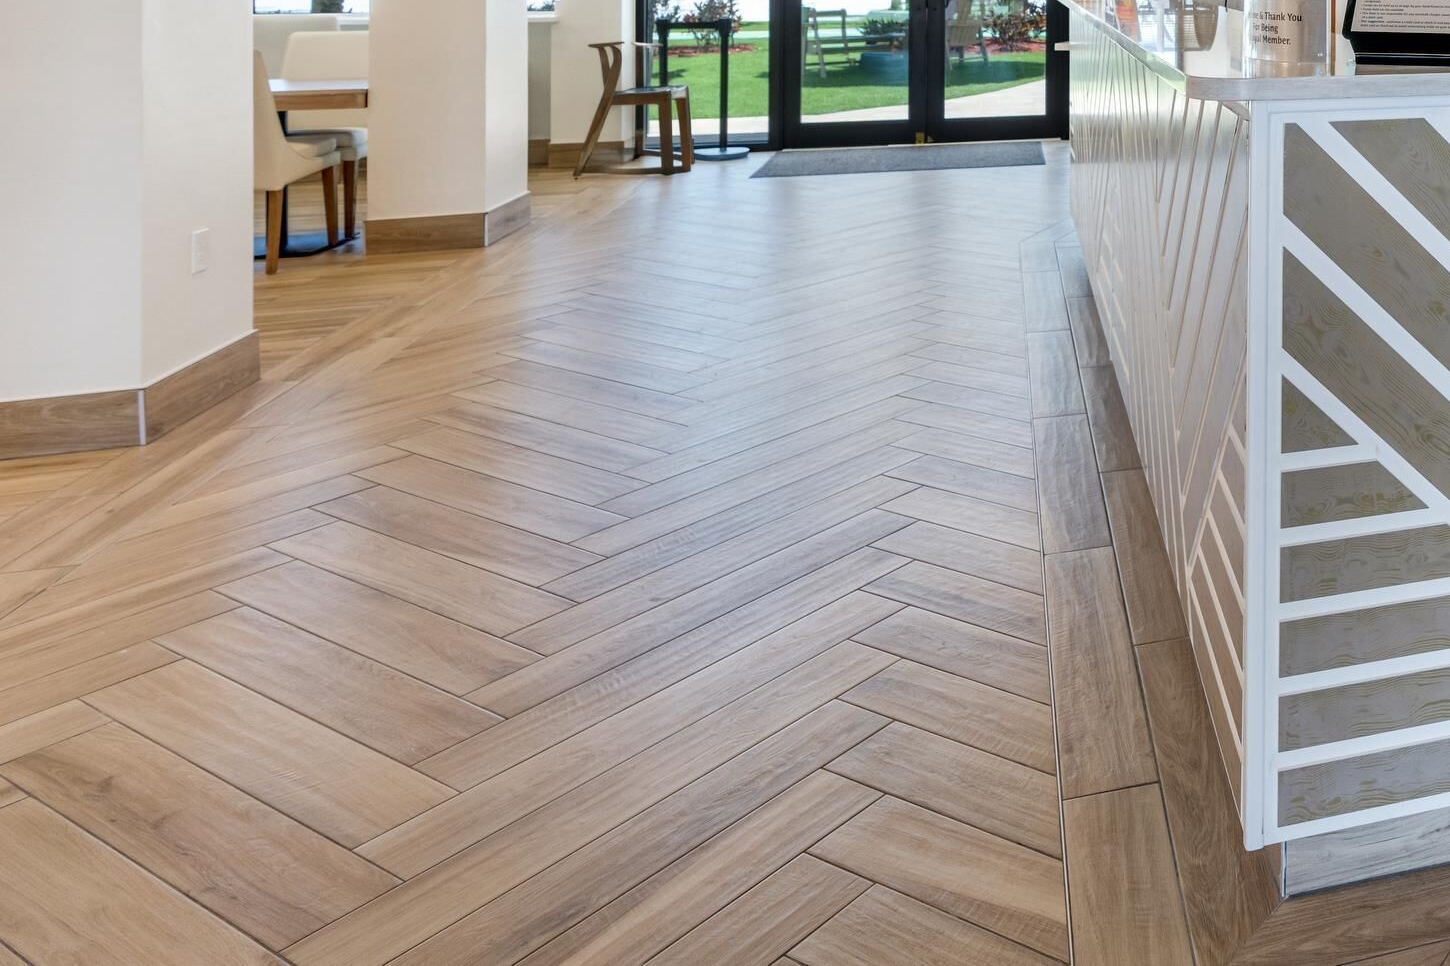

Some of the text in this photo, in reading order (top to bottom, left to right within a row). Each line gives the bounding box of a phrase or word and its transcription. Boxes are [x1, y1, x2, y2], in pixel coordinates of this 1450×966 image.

[1264, 12, 1286, 21] Thank
[1287, 13, 1302, 22] You
[1261, 23, 1278, 34] Being
[1263, 35, 1291, 45] Member.
